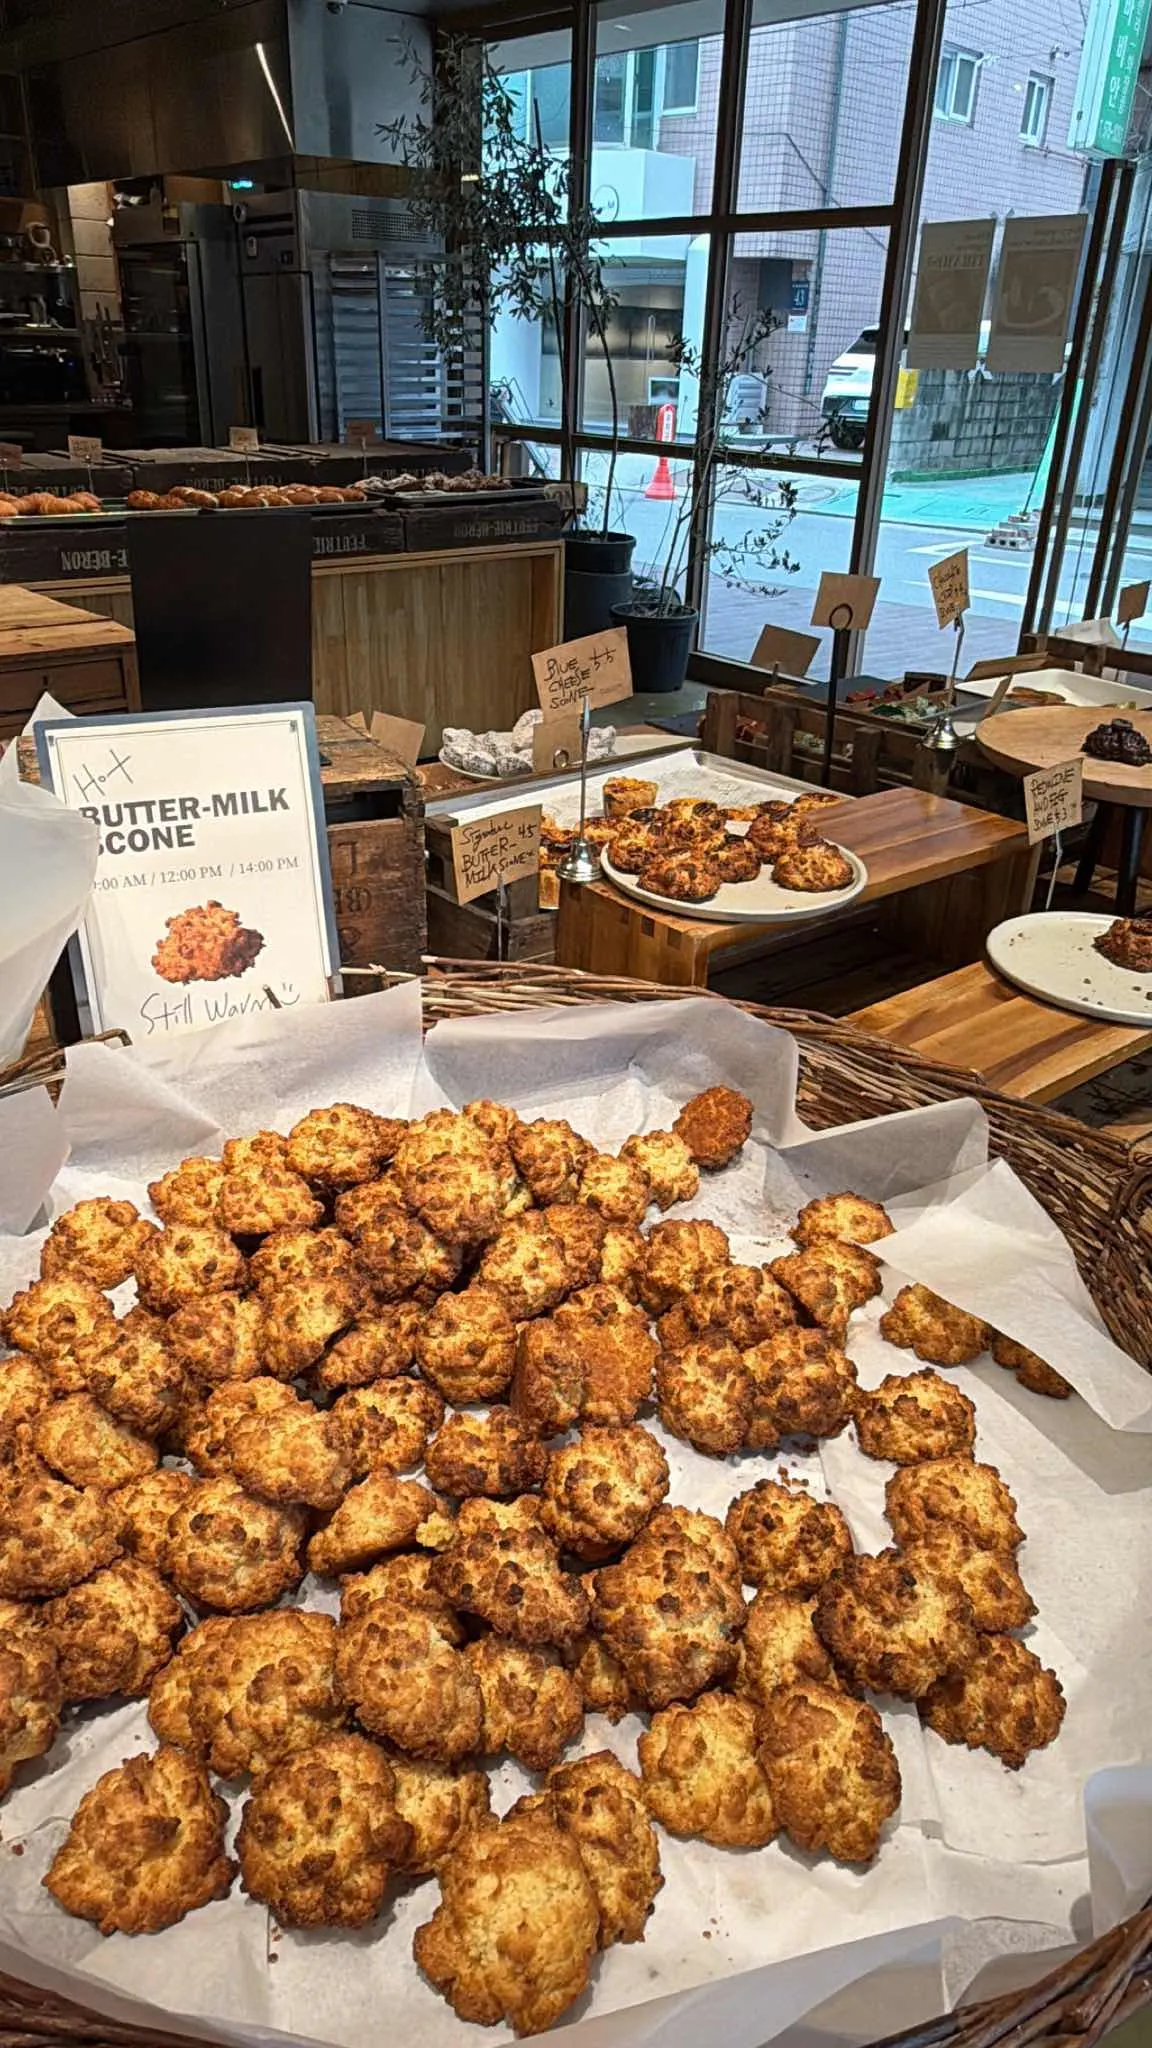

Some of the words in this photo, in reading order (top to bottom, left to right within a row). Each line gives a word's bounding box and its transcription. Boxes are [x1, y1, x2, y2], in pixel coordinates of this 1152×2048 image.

[98, 824, 196, 857] CONE
[122, 872, 147, 887] AM
[160, 869, 197, 884] 12:00
[199, 864, 223, 879] PM
[238, 859, 273, 875] 14:00
[276, 855, 300, 870] PM
[140, 992, 193, 1034] Still
